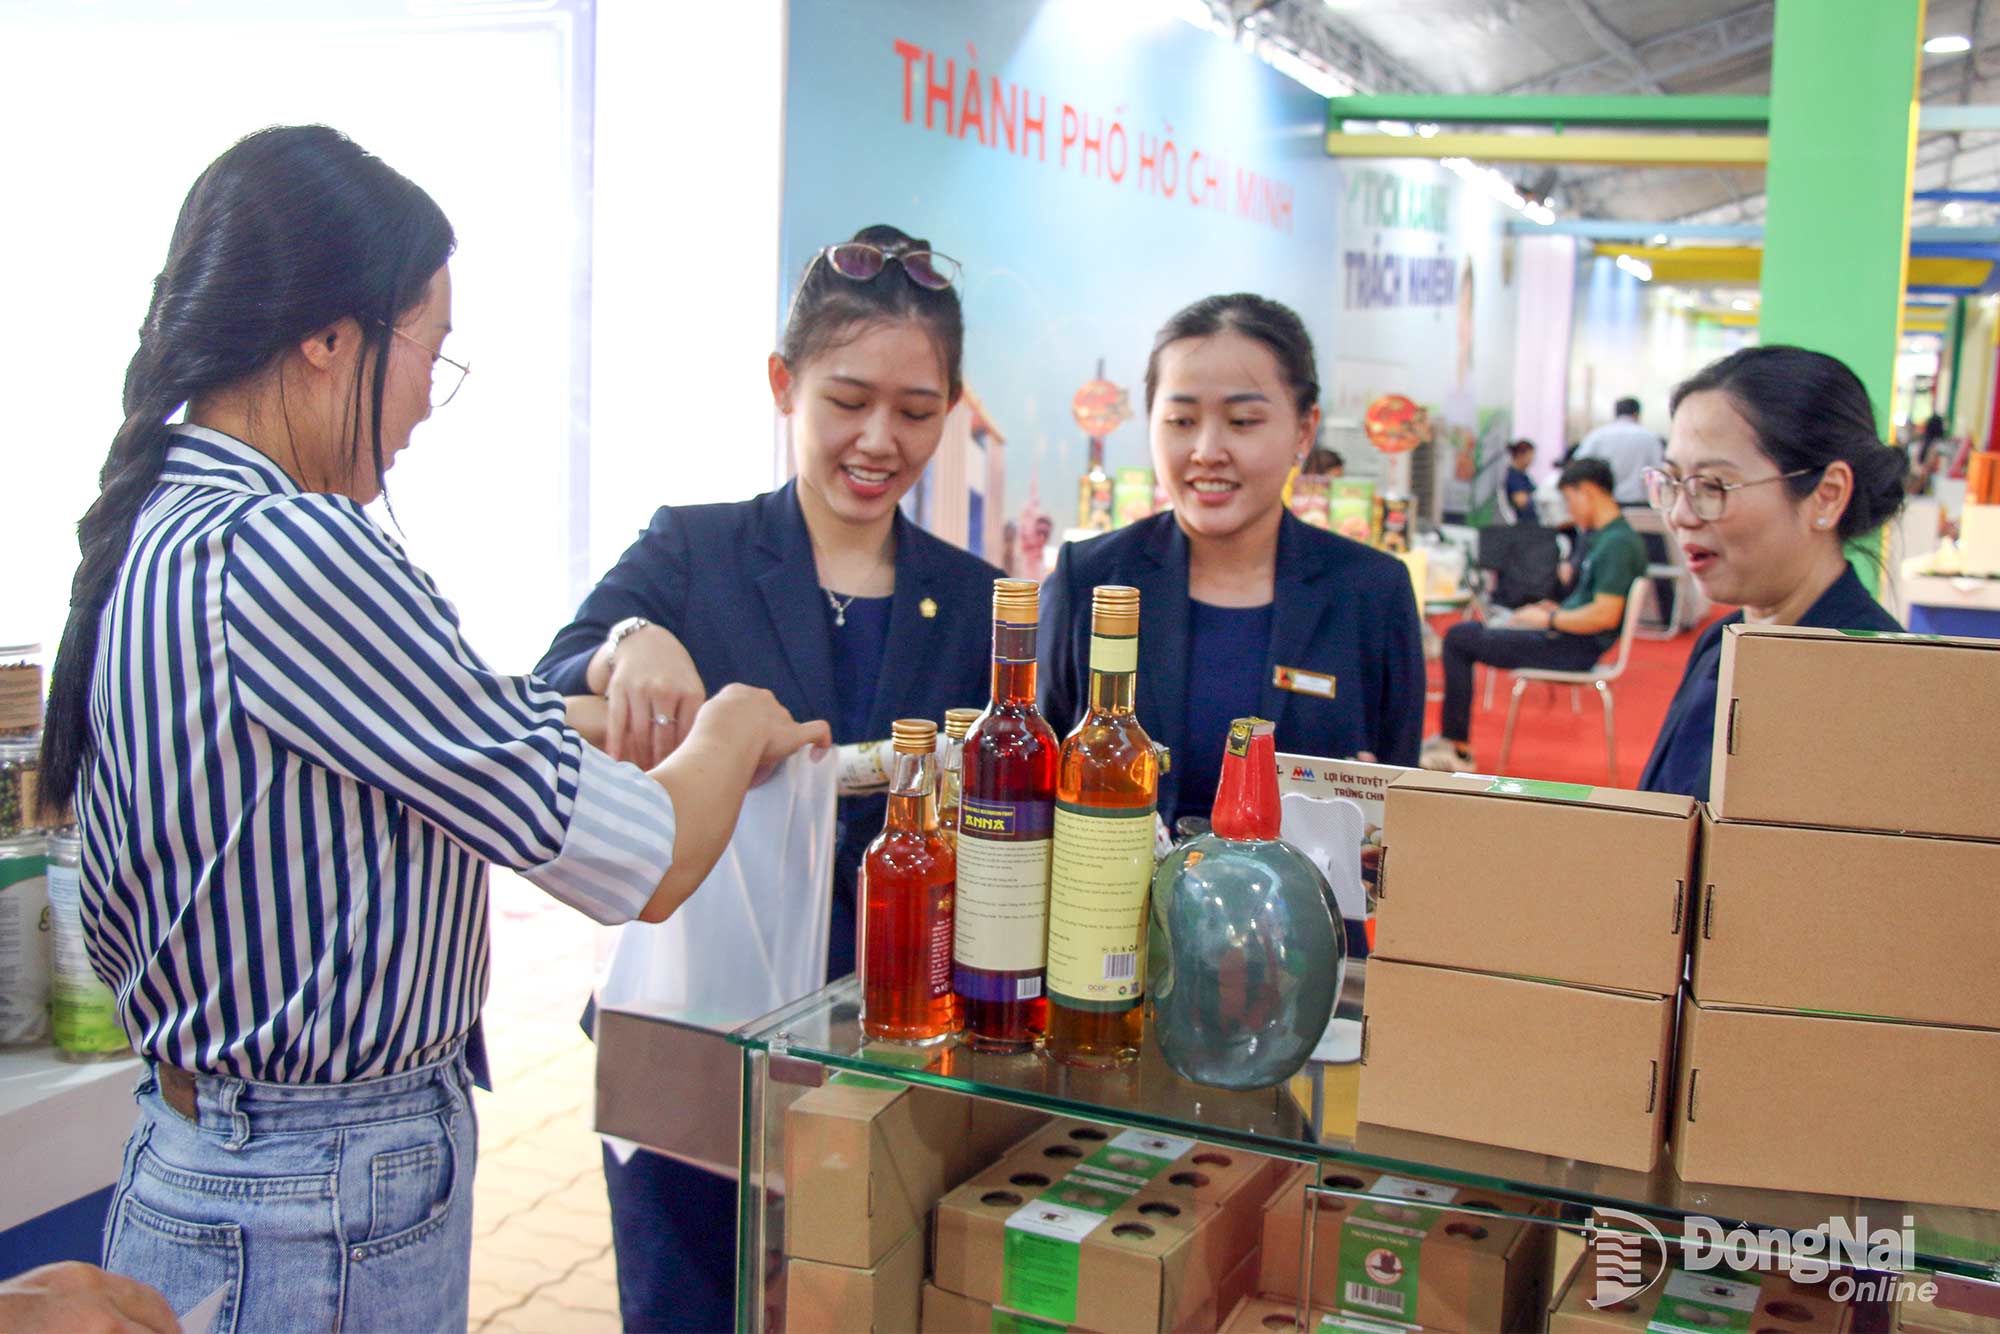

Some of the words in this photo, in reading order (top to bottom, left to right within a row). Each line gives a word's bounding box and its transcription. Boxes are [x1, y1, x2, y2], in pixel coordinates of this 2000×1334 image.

[893, 36, 1047, 162] THÀNH
[1324, 771, 1338, 783] LỢI
[1340, 771, 1354, 783] ÍCH
[1356, 775, 1384, 788] TUYỆT
[965, 814, 1005, 831] ANNA
